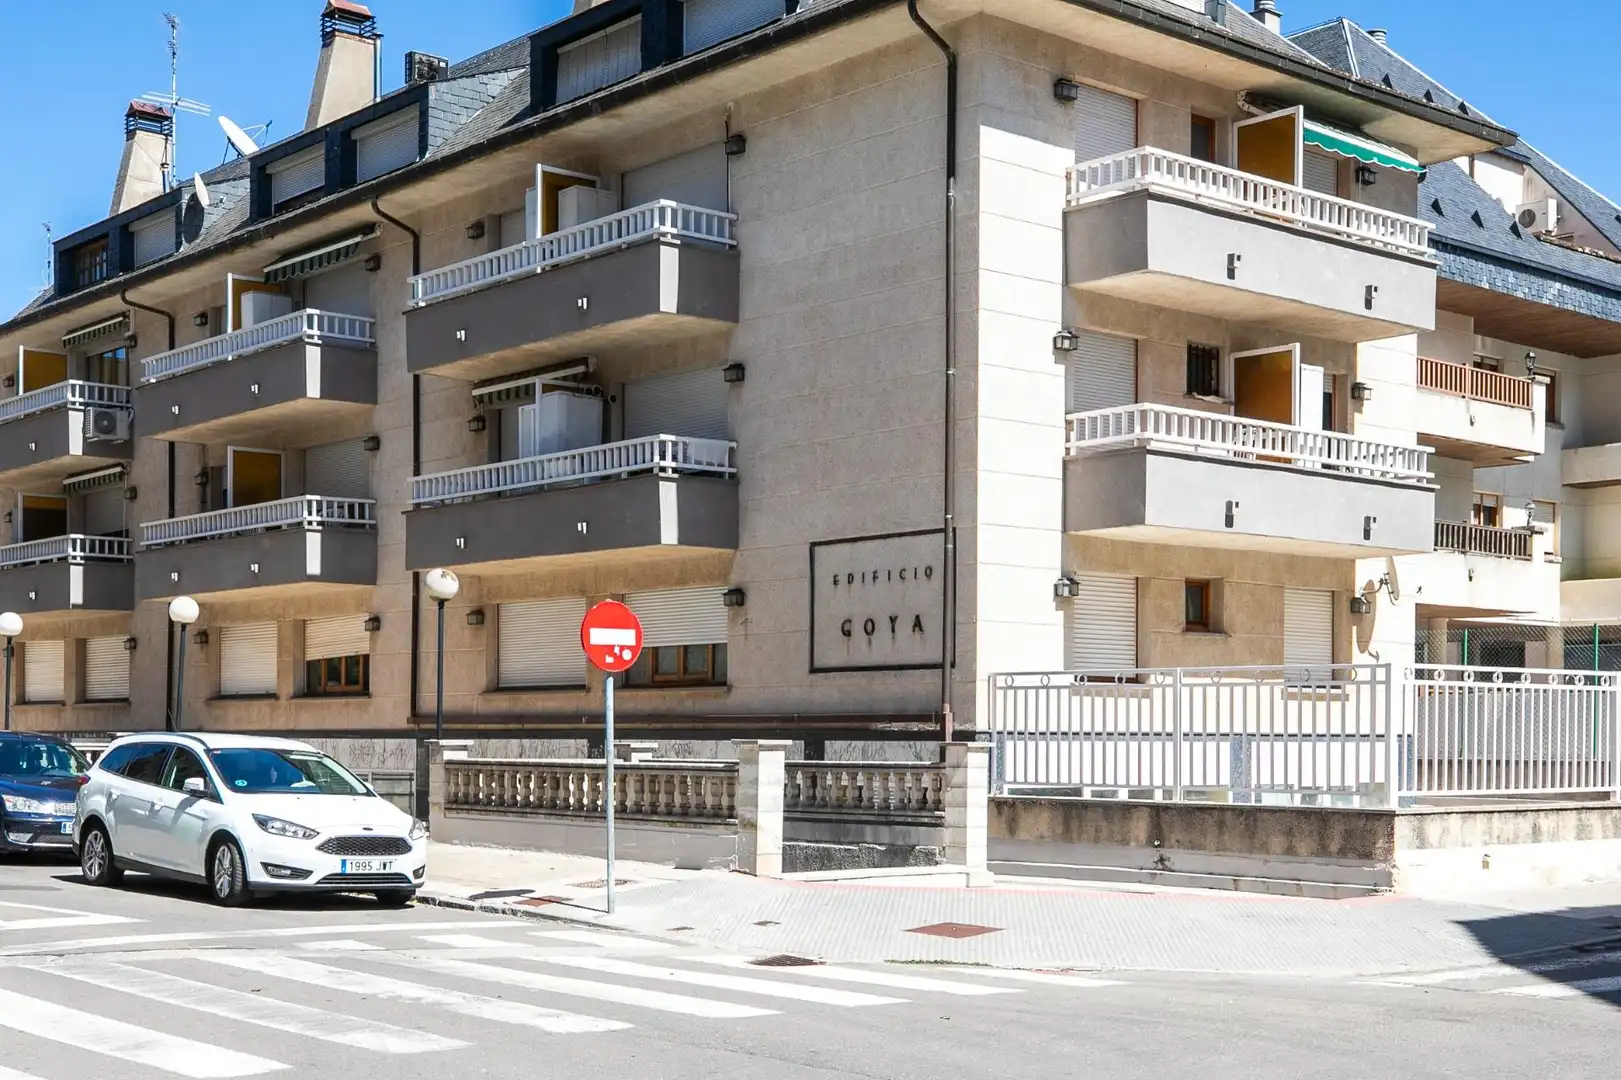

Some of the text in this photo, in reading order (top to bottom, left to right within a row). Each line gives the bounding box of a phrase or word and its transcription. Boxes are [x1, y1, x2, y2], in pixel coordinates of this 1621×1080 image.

[833, 566, 933, 586] EDIFICIO
[841, 614, 924, 637] GOYA
[350, 861, 373, 871] 1995
